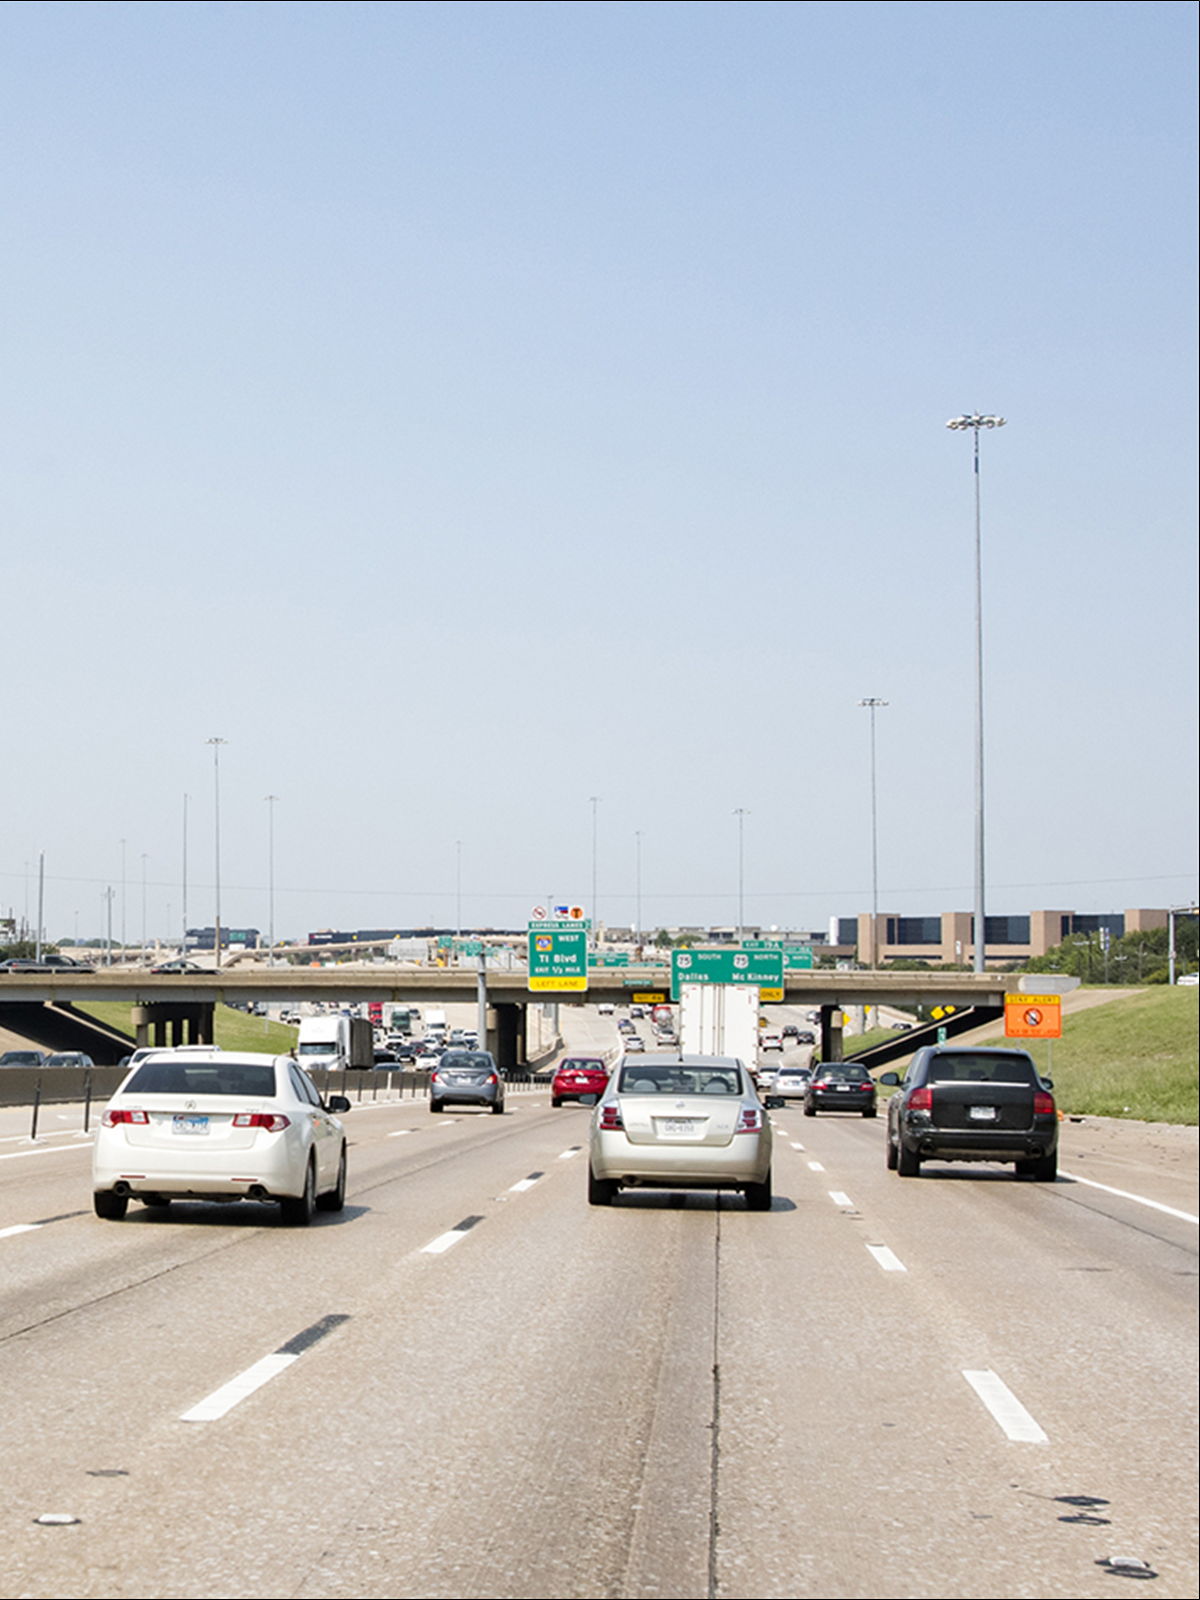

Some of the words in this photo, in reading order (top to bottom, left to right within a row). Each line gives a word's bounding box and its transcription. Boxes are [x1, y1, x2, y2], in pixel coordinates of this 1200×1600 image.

[539, 954, 549, 963] TI
[553, 954, 577, 963] Blvd
[678, 956, 690, 965] 75
[735, 956, 747, 965] 75
[678, 972, 709, 981] Dallas
